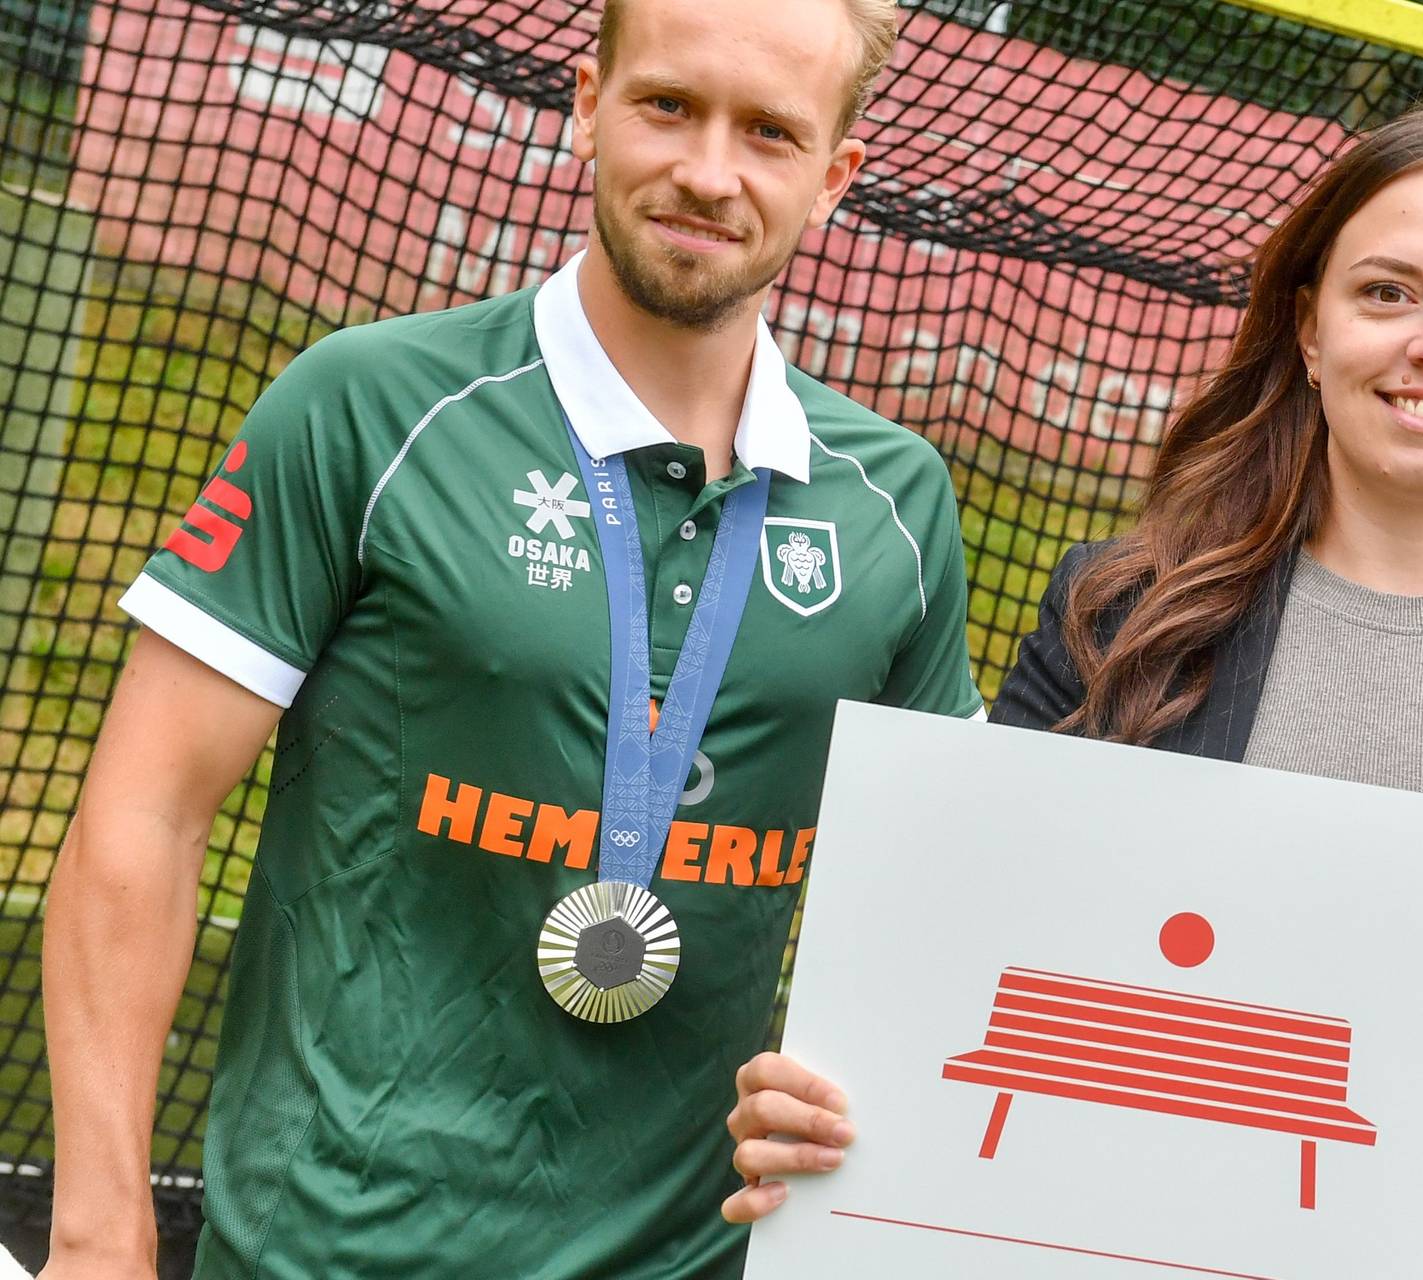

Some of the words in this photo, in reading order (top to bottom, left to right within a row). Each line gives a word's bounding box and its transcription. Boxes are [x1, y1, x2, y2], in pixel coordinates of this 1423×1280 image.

[537, 498, 566, 512] 大阪
[507, 535, 591, 572] OSAKA
[525, 562, 573, 592] 世界
[416, 773, 817, 888] HEMERLE
